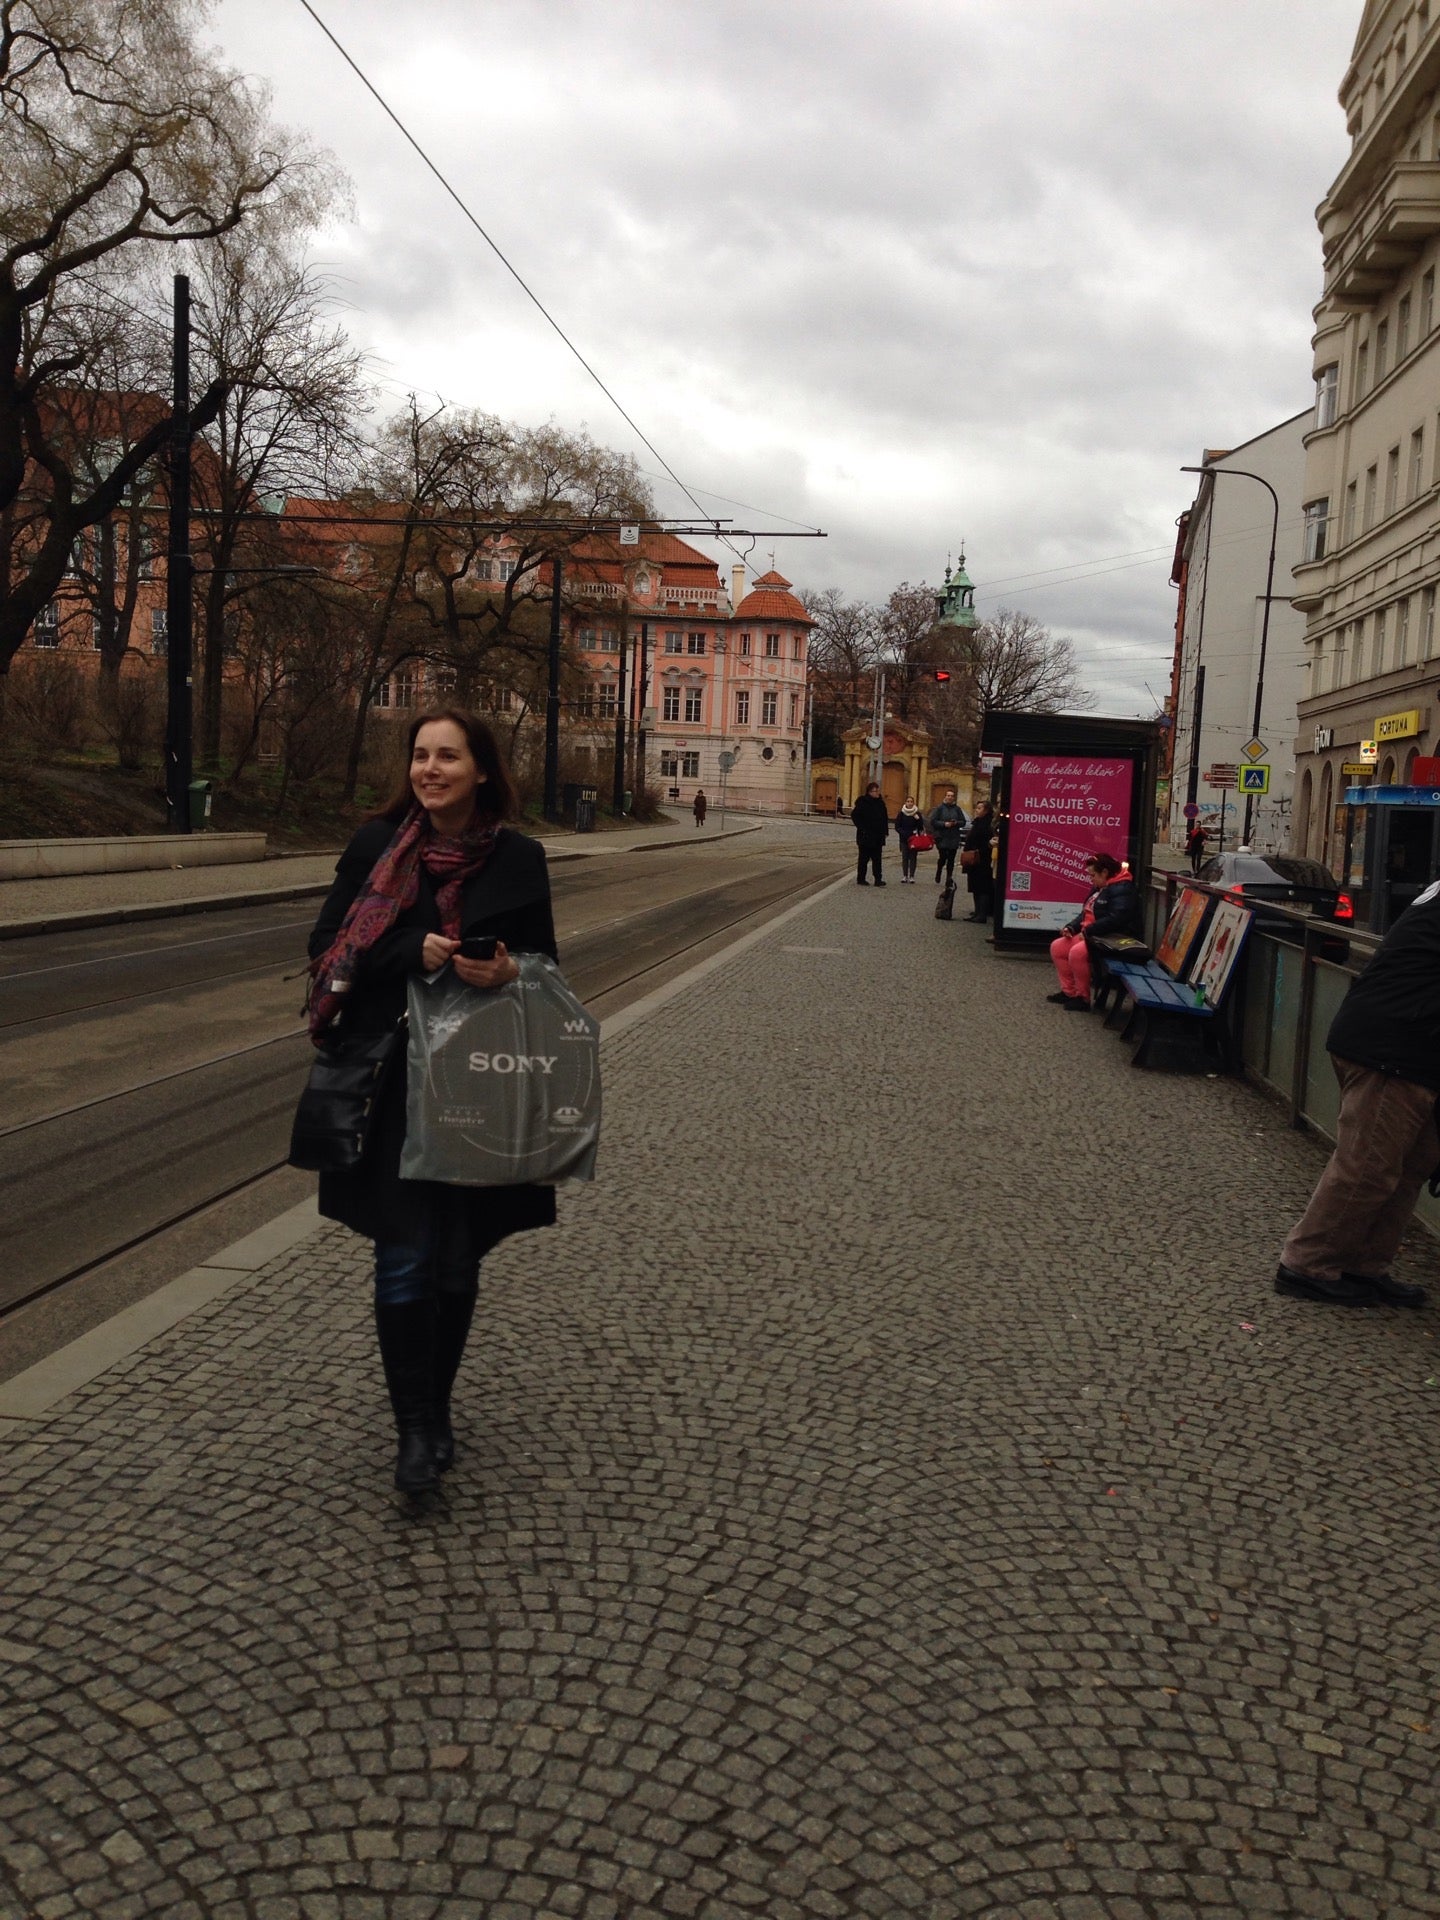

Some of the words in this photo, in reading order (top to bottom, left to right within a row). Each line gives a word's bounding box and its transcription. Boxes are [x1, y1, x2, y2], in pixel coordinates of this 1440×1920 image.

[1379, 717, 1408, 736] FORTUNA
[1046, 778, 1063, 790] Tak
[1061, 782, 1077, 793] pro
[1025, 797, 1084, 810] HLASUJTE
[1097, 803, 1112, 811] na
[1036, 837, 1064, 852] soutěž
[1029, 845, 1064, 862] ordinaci
[1064, 858, 1084, 870] roku
[1033, 855, 1059, 872] České
[469, 1052, 557, 1074] SONY
